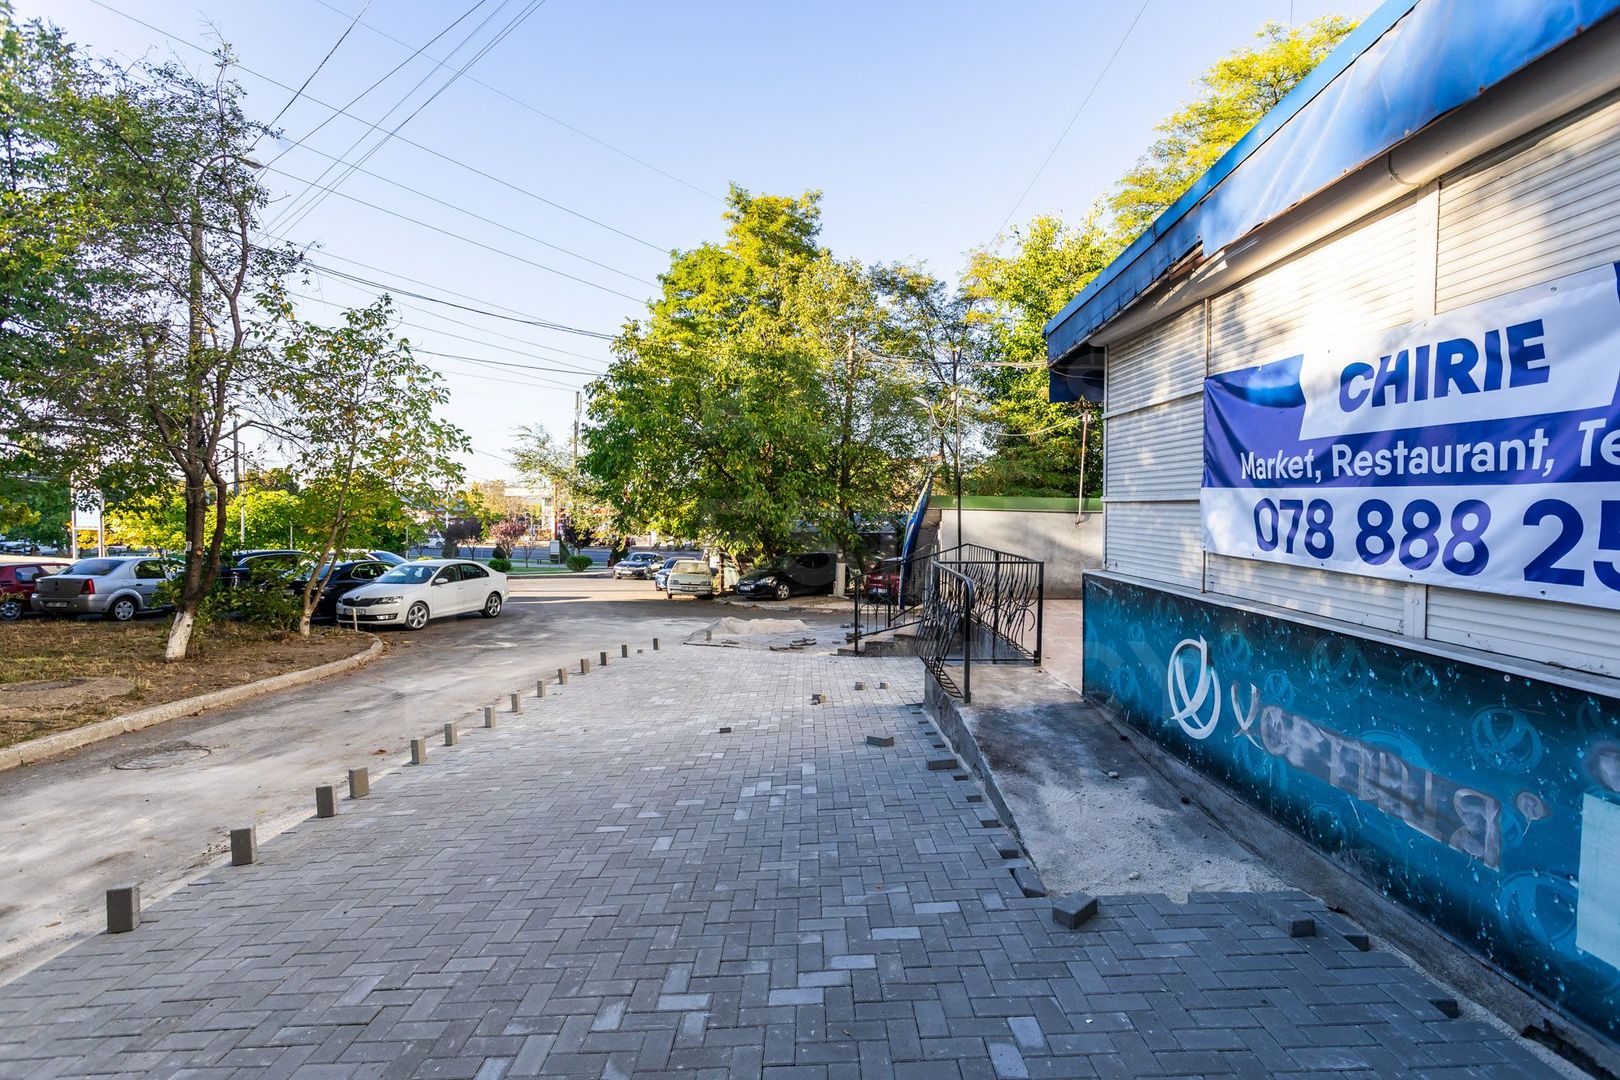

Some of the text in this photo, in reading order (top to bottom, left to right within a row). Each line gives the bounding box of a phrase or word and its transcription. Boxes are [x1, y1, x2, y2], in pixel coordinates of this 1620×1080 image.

[1339, 318, 1551, 414] CHIRIE
[1240, 447, 1322, 483] Market,
[1332, 427, 1555, 478] Restaurant,
[1253, 497, 1335, 560] 078
[1355, 498, 1492, 577] 888
